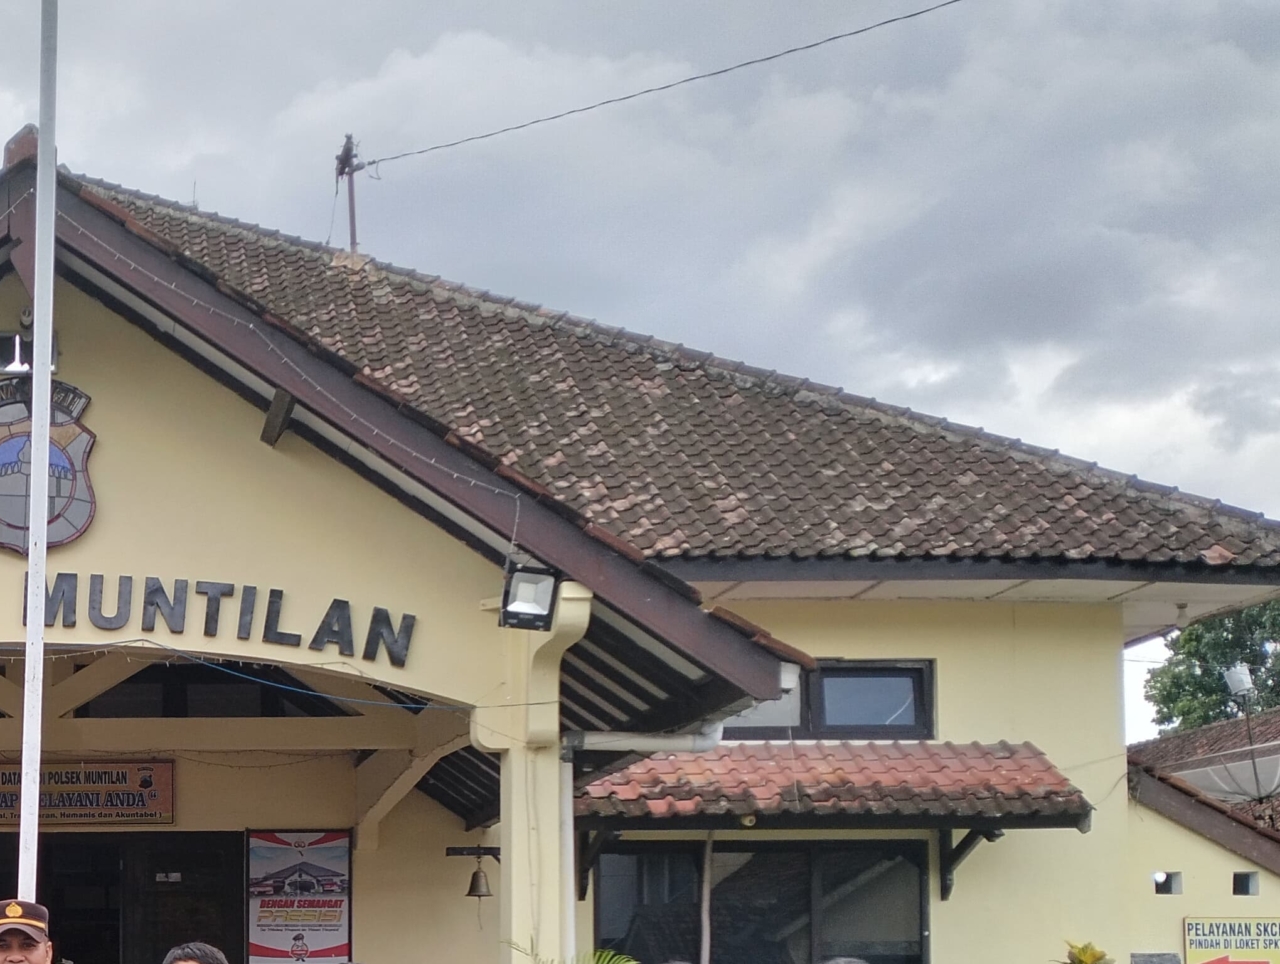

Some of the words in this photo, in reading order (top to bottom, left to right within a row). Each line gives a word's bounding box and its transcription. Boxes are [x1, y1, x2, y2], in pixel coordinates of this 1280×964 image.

[22, 571, 417, 668] MUNTILAN
[1, 771, 22, 785] DATA
[48, 771, 81, 785] POLSEK
[83, 770, 127, 784] MUNTILAN
[39, 792, 101, 808] ELAYANI
[104, 792, 147, 808] ANDA
[60, 811, 96, 819] Humanis
[1187, 922, 1252, 937] PELAYANAN
[1189, 938, 1221, 950] PINDAH
[1223, 938, 1233, 950] DI
[1235, 938, 1261, 950] LOKET
[1263, 938, 1280, 950] SPK
